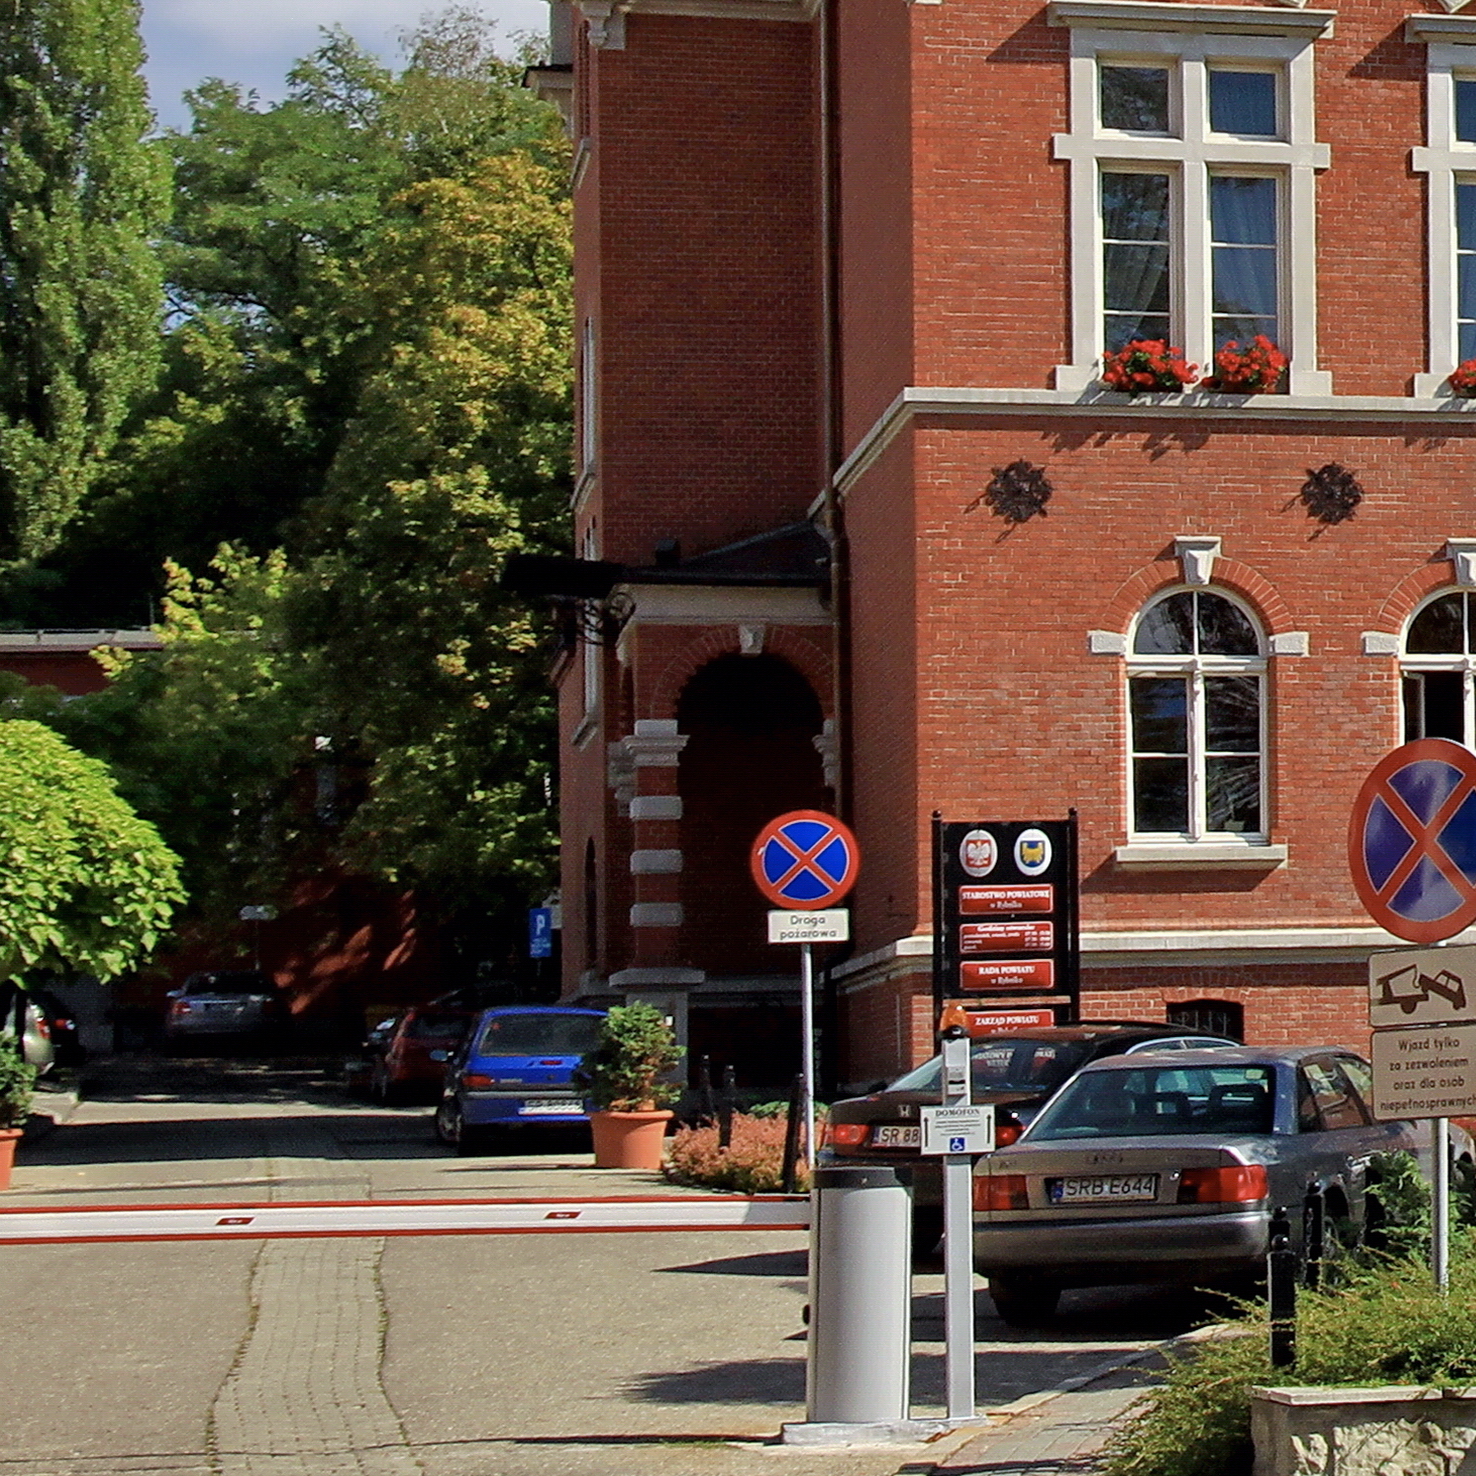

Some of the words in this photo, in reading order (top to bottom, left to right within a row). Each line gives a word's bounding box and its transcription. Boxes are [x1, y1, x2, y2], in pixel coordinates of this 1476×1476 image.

[962, 890, 1006, 899] STAROSTWO
[1006, 889, 1050, 898] POWIATOWE
[536, 914, 546, 935] P
[790, 915, 826, 928] Droga
[780, 928, 837, 942] pożarowa
[978, 967, 1000, 975] RADA
[1001, 965, 1036, 974] POWIATU
[1006, 1015, 1040, 1024] POWIATU
[1398, 1038, 1430, 1052] Wjazd
[1434, 1036, 1460, 1051] tylko
[1389, 1062, 1401, 1071] za
[1405, 1057, 1469, 1070] zezwoleniem
[1393, 1080, 1415, 1090] oraz
[1420, 1077, 1436, 1089] dla
[935, 1108, 980, 1117] DOMOFON
[881, 1128, 901, 1144] SR
[902, 1127, 920, 1143] 88
[1066, 1178, 1104, 1196] SRB
[1109, 1176, 1153, 1195] E644
